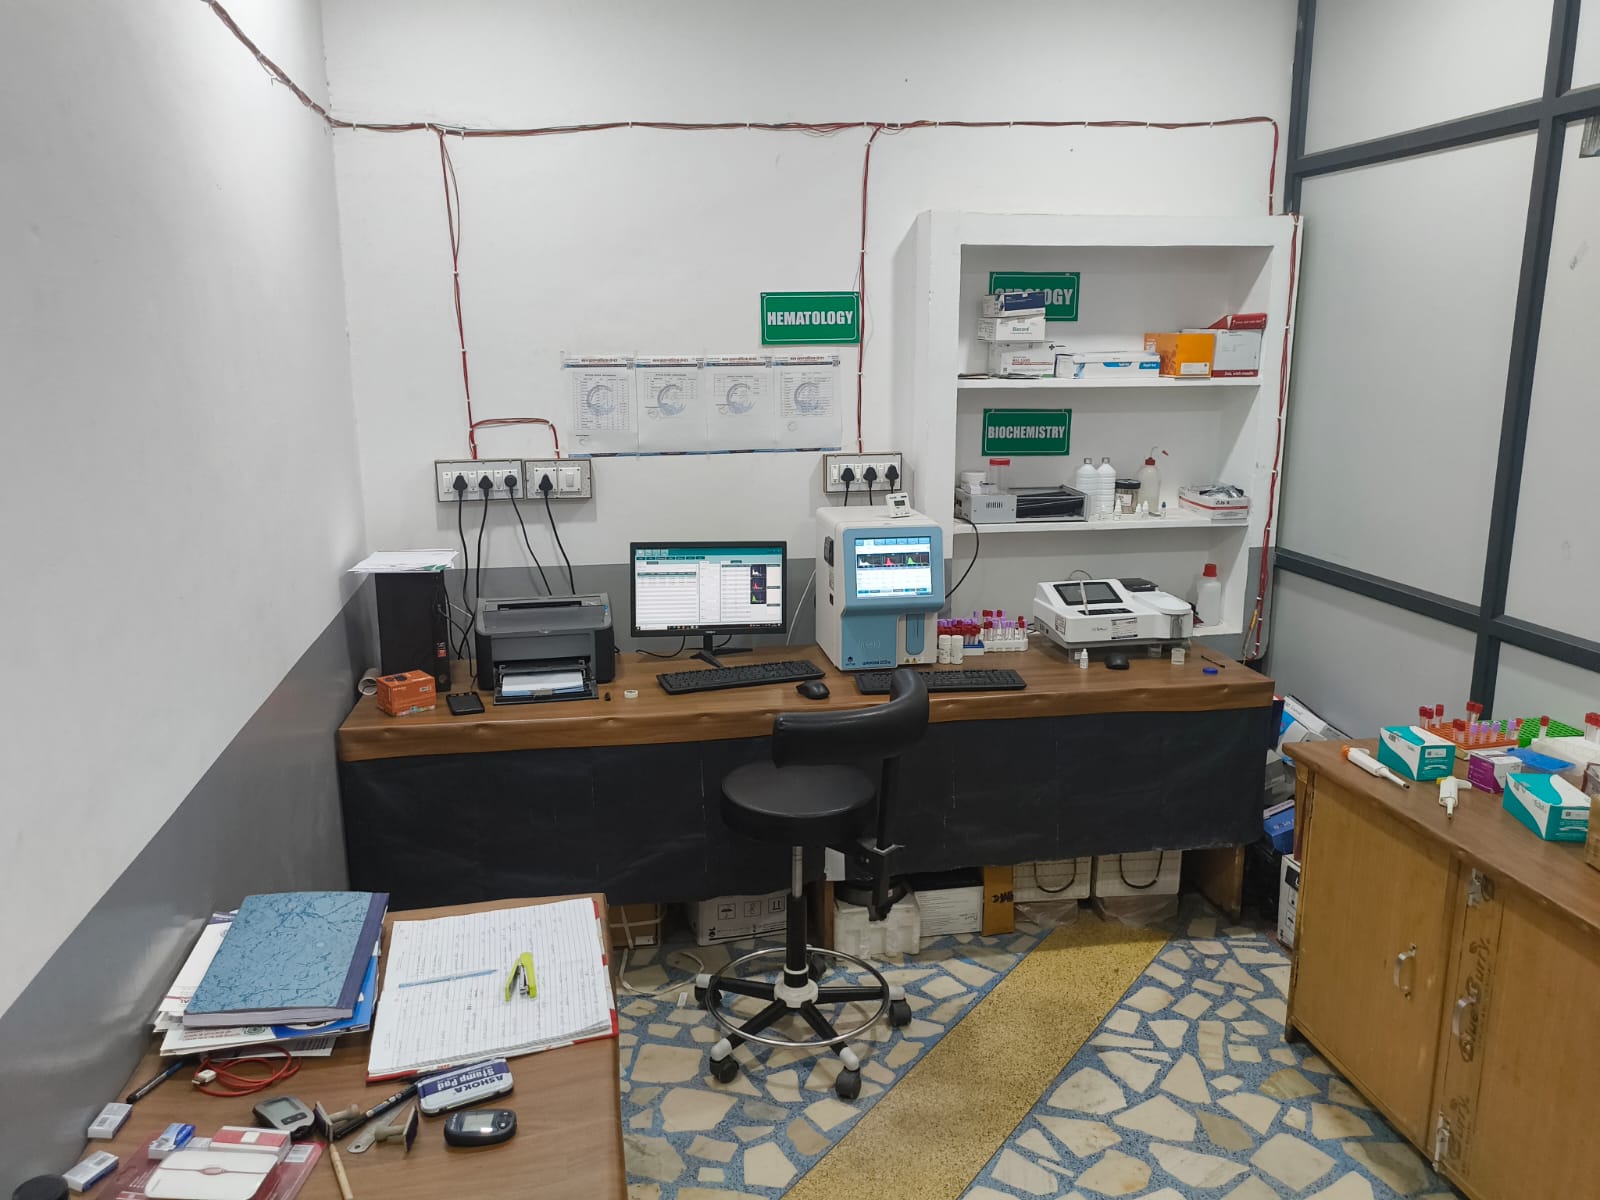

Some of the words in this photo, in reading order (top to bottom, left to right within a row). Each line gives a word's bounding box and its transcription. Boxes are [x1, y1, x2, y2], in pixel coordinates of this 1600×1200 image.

[767, 311, 854, 325] HEMATOLOGY
[987, 425, 1065, 439] BIOCHEMISTRY
[459, 1067, 495, 1083] Stamp
[436, 1079, 458, 1092] Pad
[454, 1074, 504, 1093] ASHOKA
